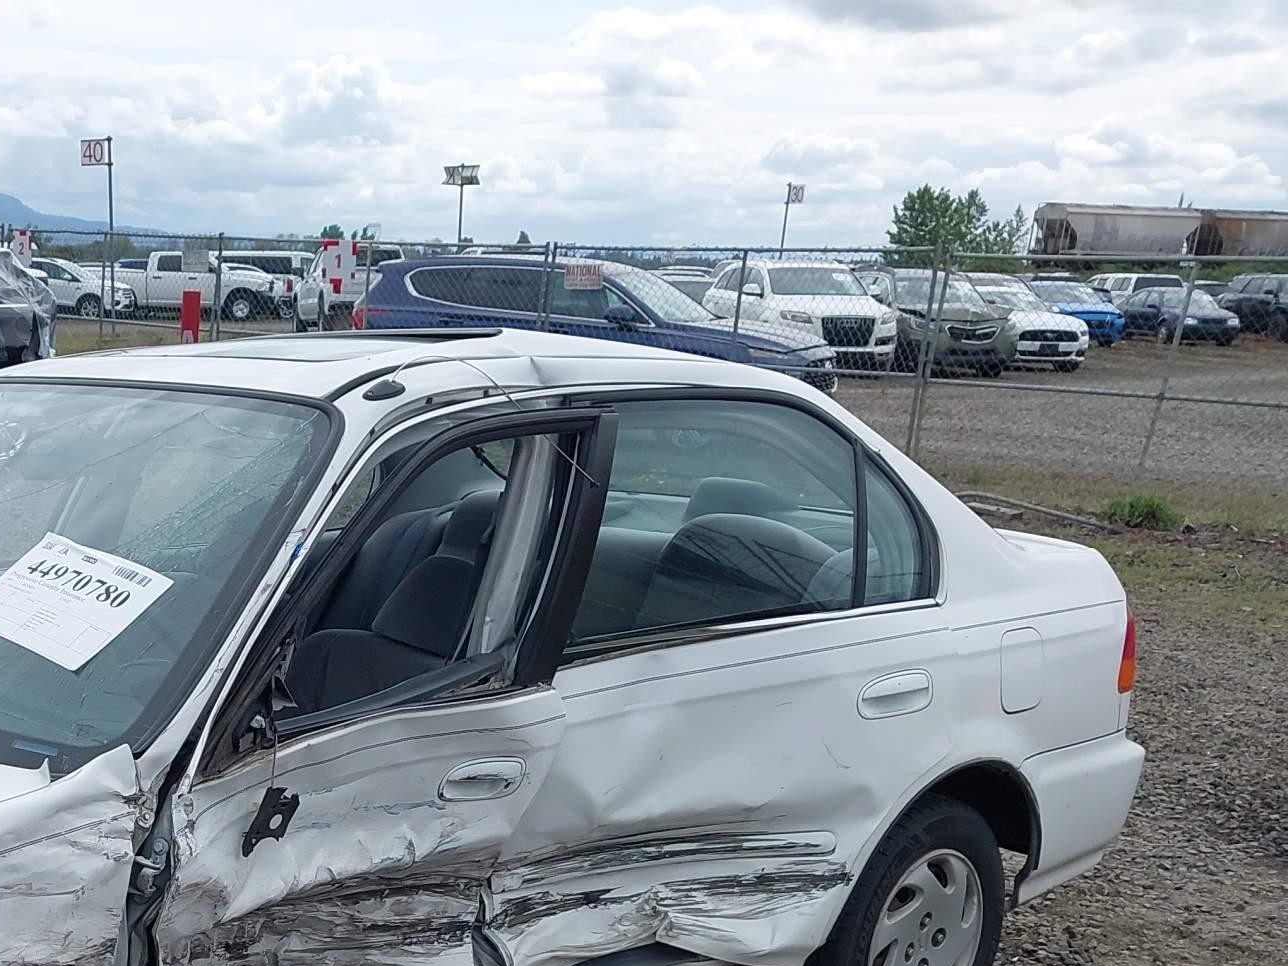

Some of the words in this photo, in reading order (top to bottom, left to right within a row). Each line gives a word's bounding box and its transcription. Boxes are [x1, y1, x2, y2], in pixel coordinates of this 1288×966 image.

[83, 141, 103, 163] 40
[791, 185, 804, 203] 30
[18, 241, 25, 256] 2
[334, 253, 342, 269] 1
[566, 263, 601, 277] NATIONAL
[27, 559, 131, 608] 44970780
